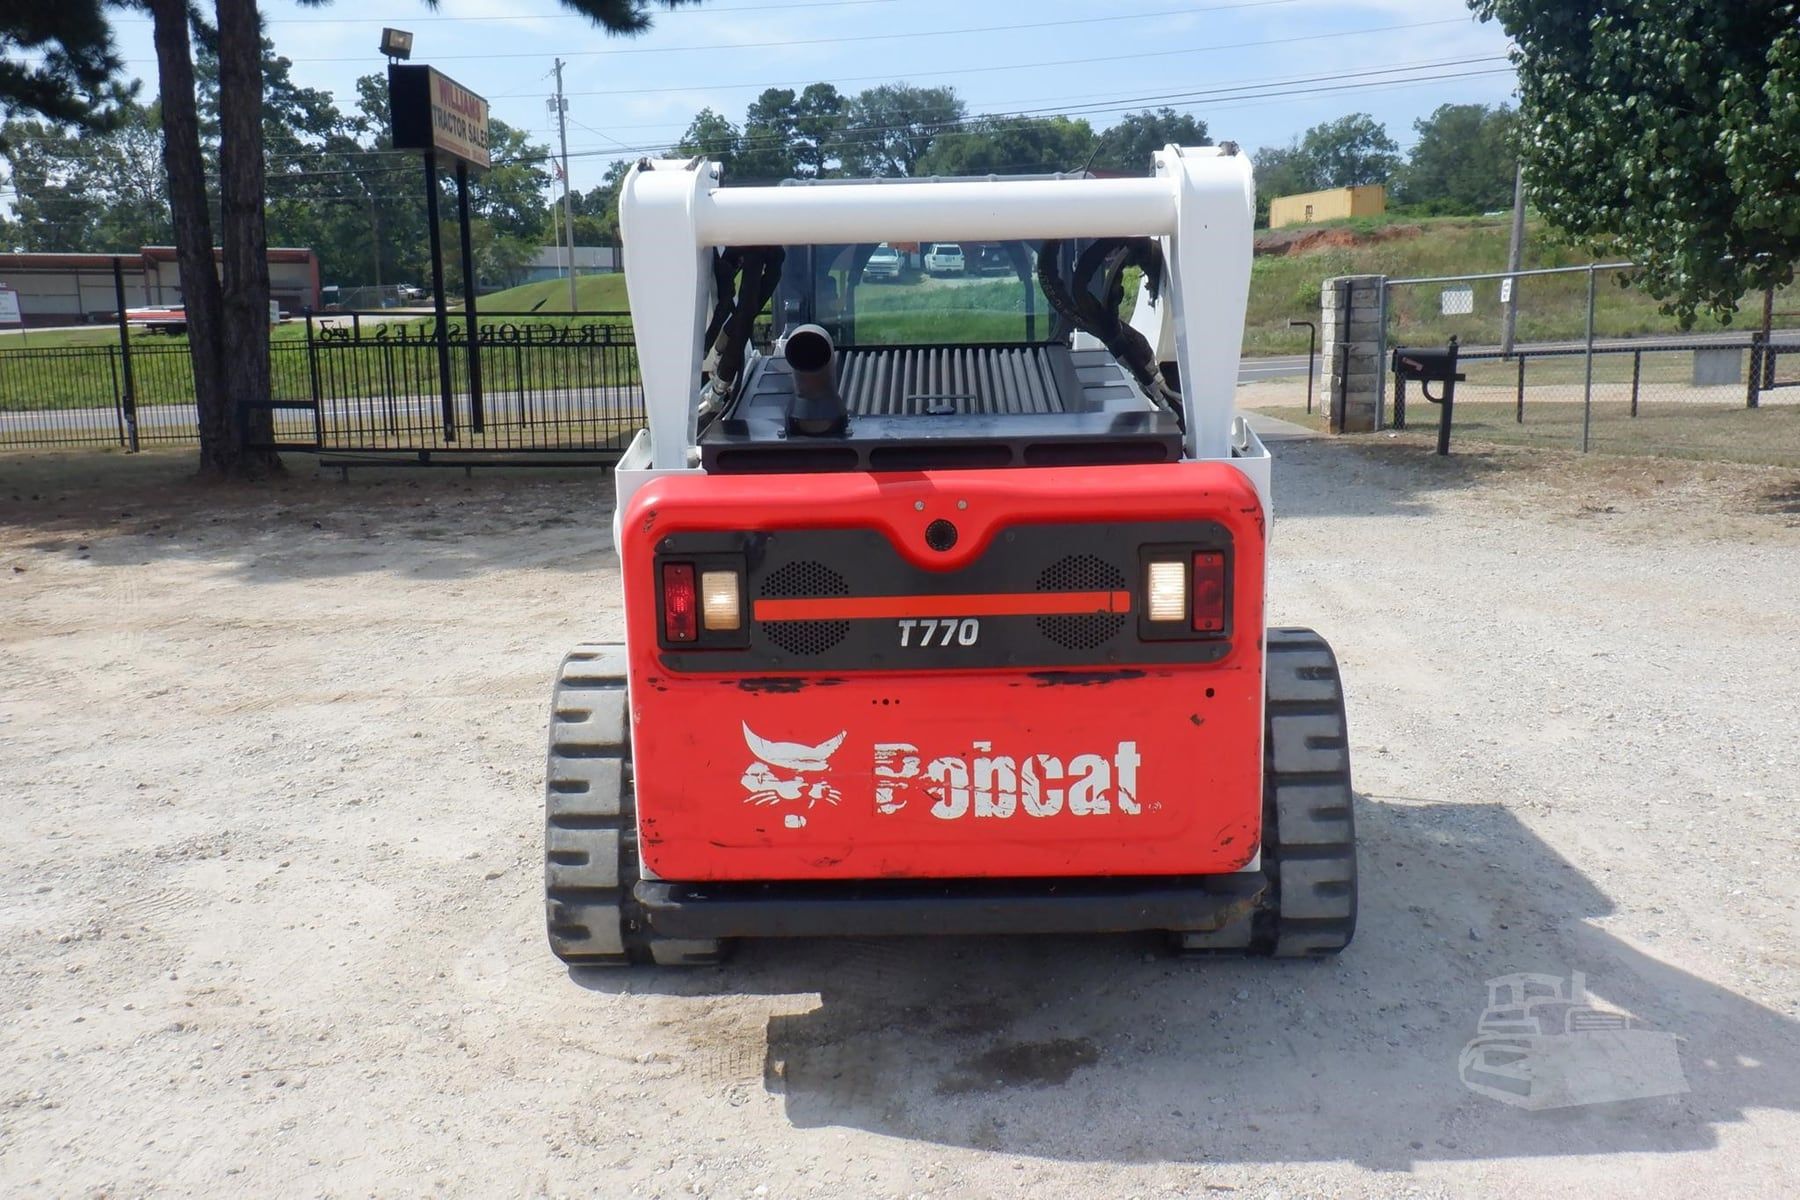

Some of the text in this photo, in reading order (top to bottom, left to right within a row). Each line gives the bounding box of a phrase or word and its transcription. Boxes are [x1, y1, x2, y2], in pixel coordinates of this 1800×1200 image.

[432, 104, 489, 151] TRACTOR SALES
[899, 618, 979, 647] T770
[873, 741, 1141, 819] Bobcat
